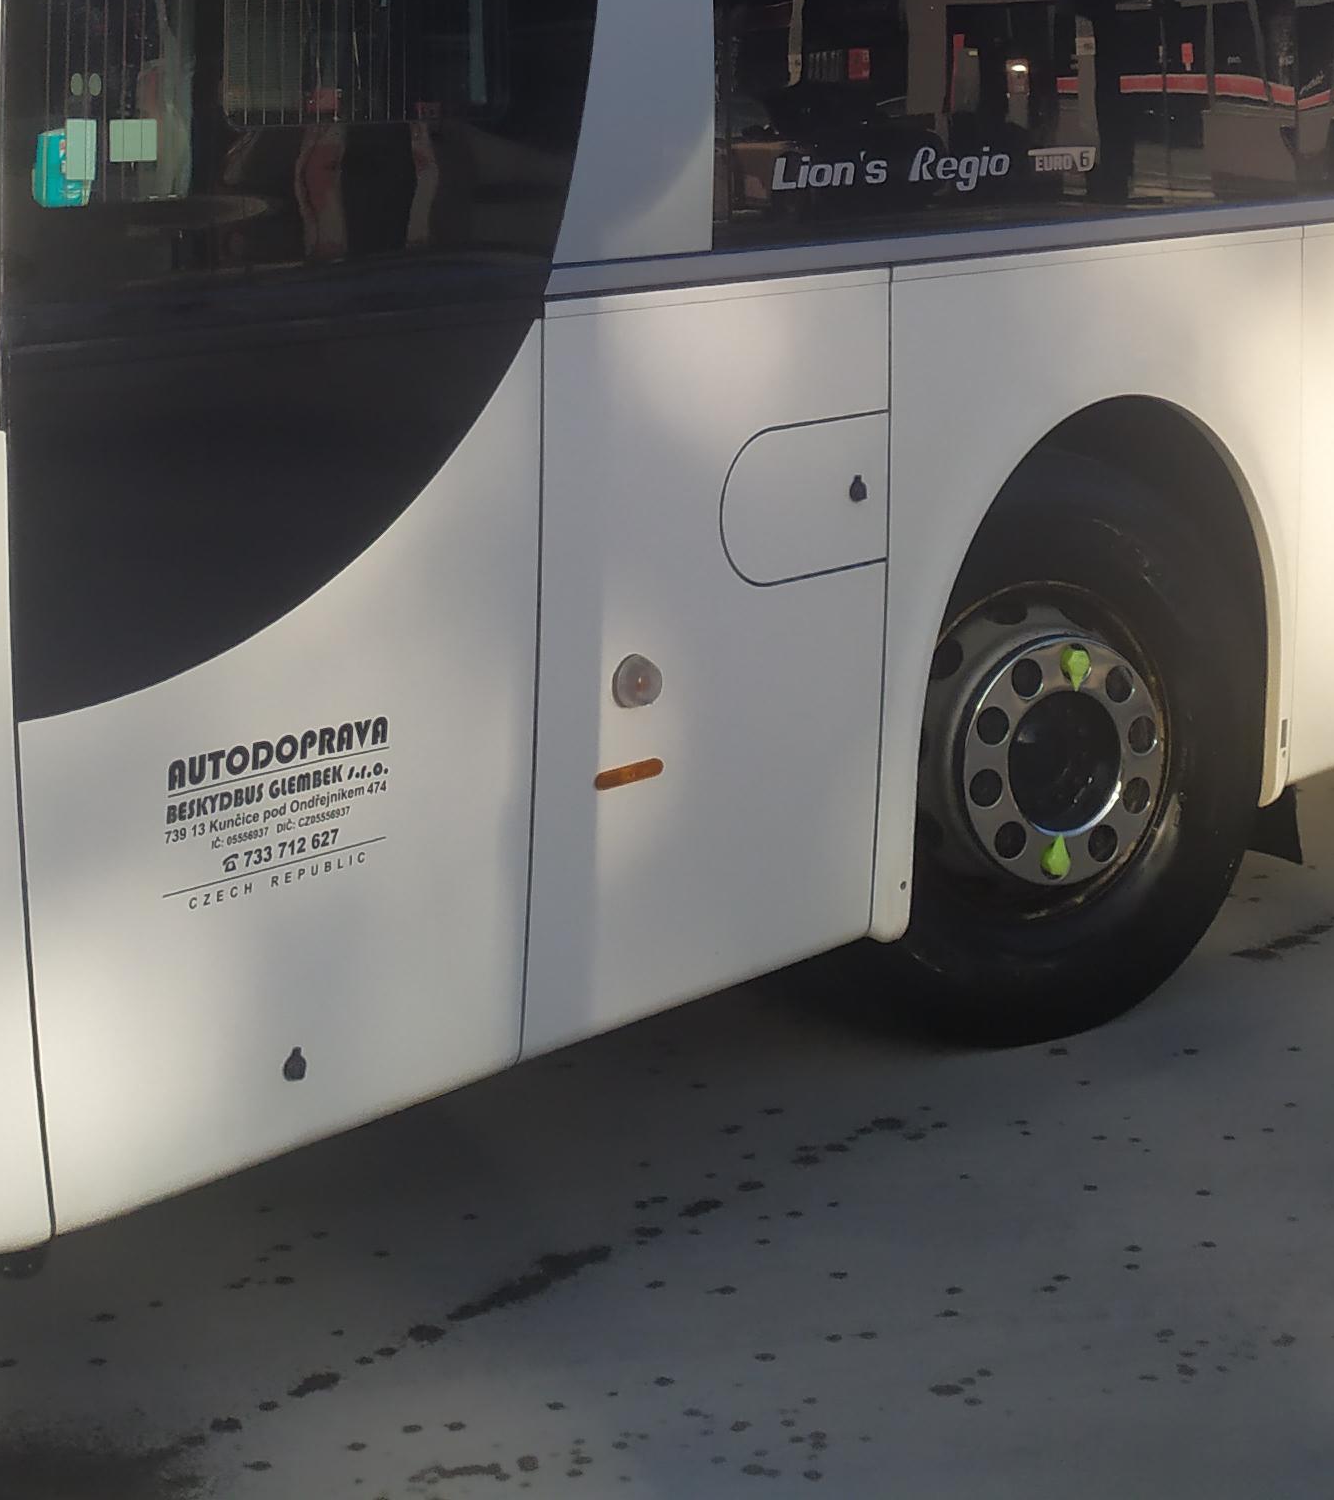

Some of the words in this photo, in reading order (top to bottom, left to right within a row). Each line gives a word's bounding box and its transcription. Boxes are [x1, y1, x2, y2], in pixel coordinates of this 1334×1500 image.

[771, 150, 887, 191] Lion's
[908, 146, 1011, 191] Regio
[1034, 154, 1074, 173] EURO
[168, 716, 388, 791] AUTODOPRAVA
[164, 827, 187, 844] 739
[191, 822, 205, 837] 13
[209, 811, 259, 833] Kunčice
[263, 804, 287, 823] pod
[290, 786, 365, 812] Ondřejníkem
[366, 780, 387, 795] 474
[166, 783, 264, 824] BESKYDBUS
[269, 764, 343, 799] GLEMBEK
[347, 762, 389, 780] s.r.o.
[244, 846, 272, 867] 733
[278, 837, 306, 858] 712
[311, 828, 339, 849] 627
[276, 819, 296, 834] DIČ:
[188, 883, 253, 909] CZECH
[270, 852, 366, 887] REPUBLIC
